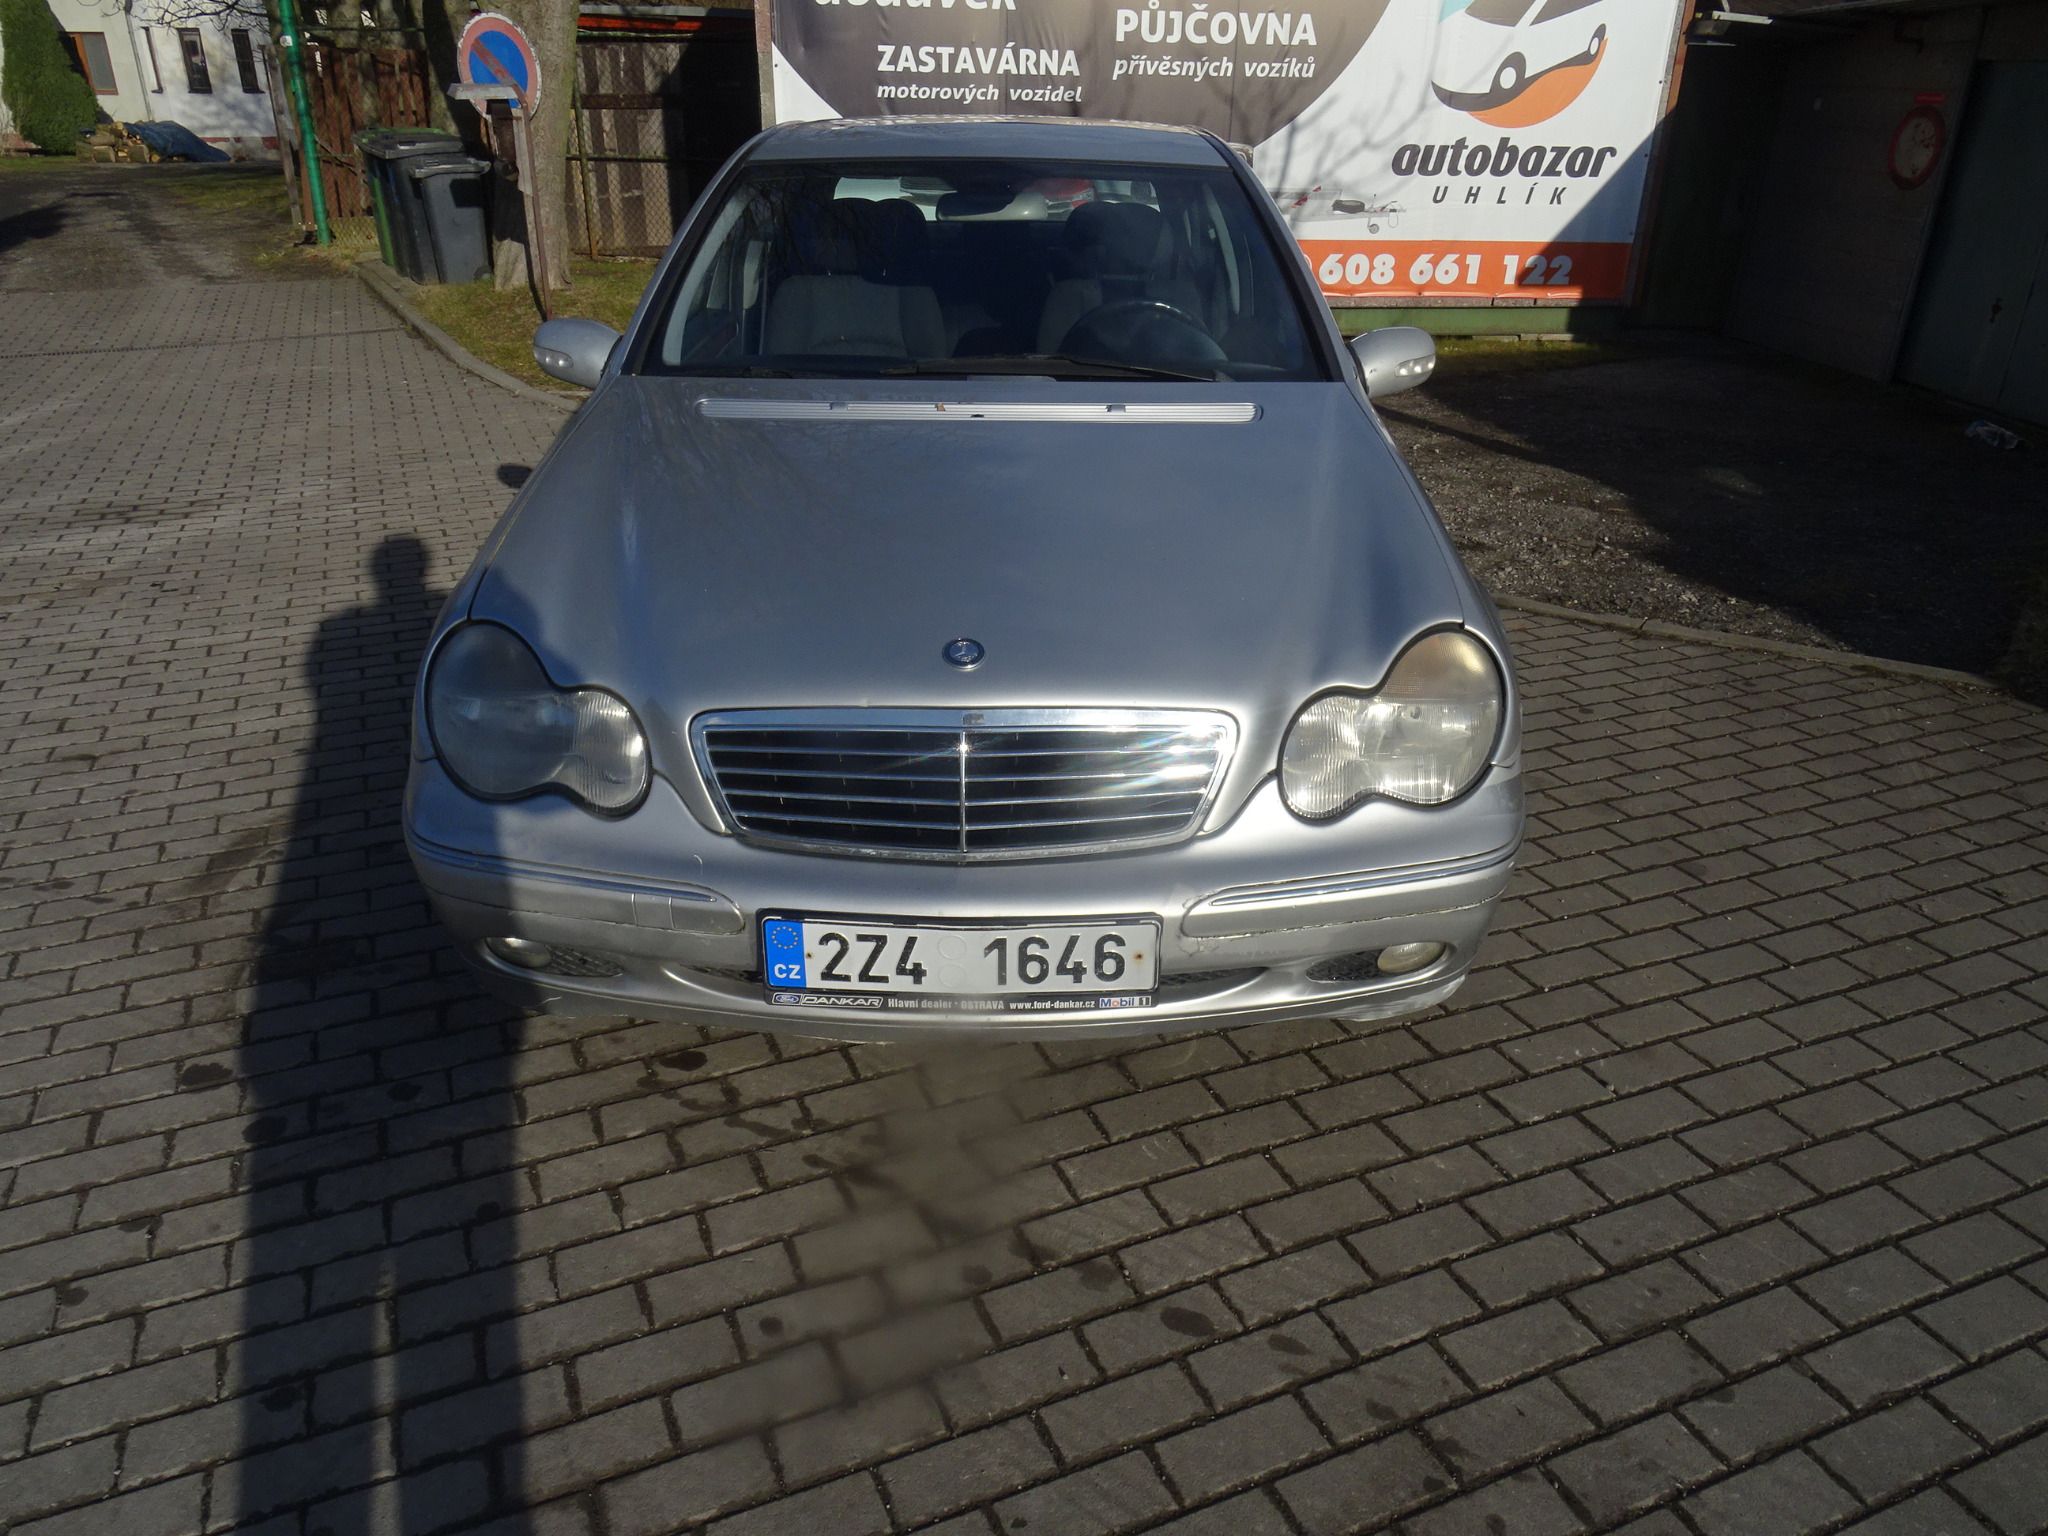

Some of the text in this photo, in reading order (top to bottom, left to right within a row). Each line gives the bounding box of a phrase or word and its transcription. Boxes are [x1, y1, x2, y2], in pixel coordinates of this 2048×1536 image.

[1115, 0, 1318, 46] PŮJČOVNA
[877, 42, 1081, 77] ZASTAVÁRNA
[1113, 55, 1316, 82] přívěsných vozíků
[877, 83, 1083, 105] motorových vozidel
[1391, 137, 1618, 178] autobazar
[1318, 253, 1573, 286] 608 661 122
[774, 964, 801, 980] CZ
[818, 931, 1126, 986] 2Z4 1646
[1010, 1000, 1095, 1010] www.ford-dankar.cz
[1100, 997, 1135, 1008] Mobil
